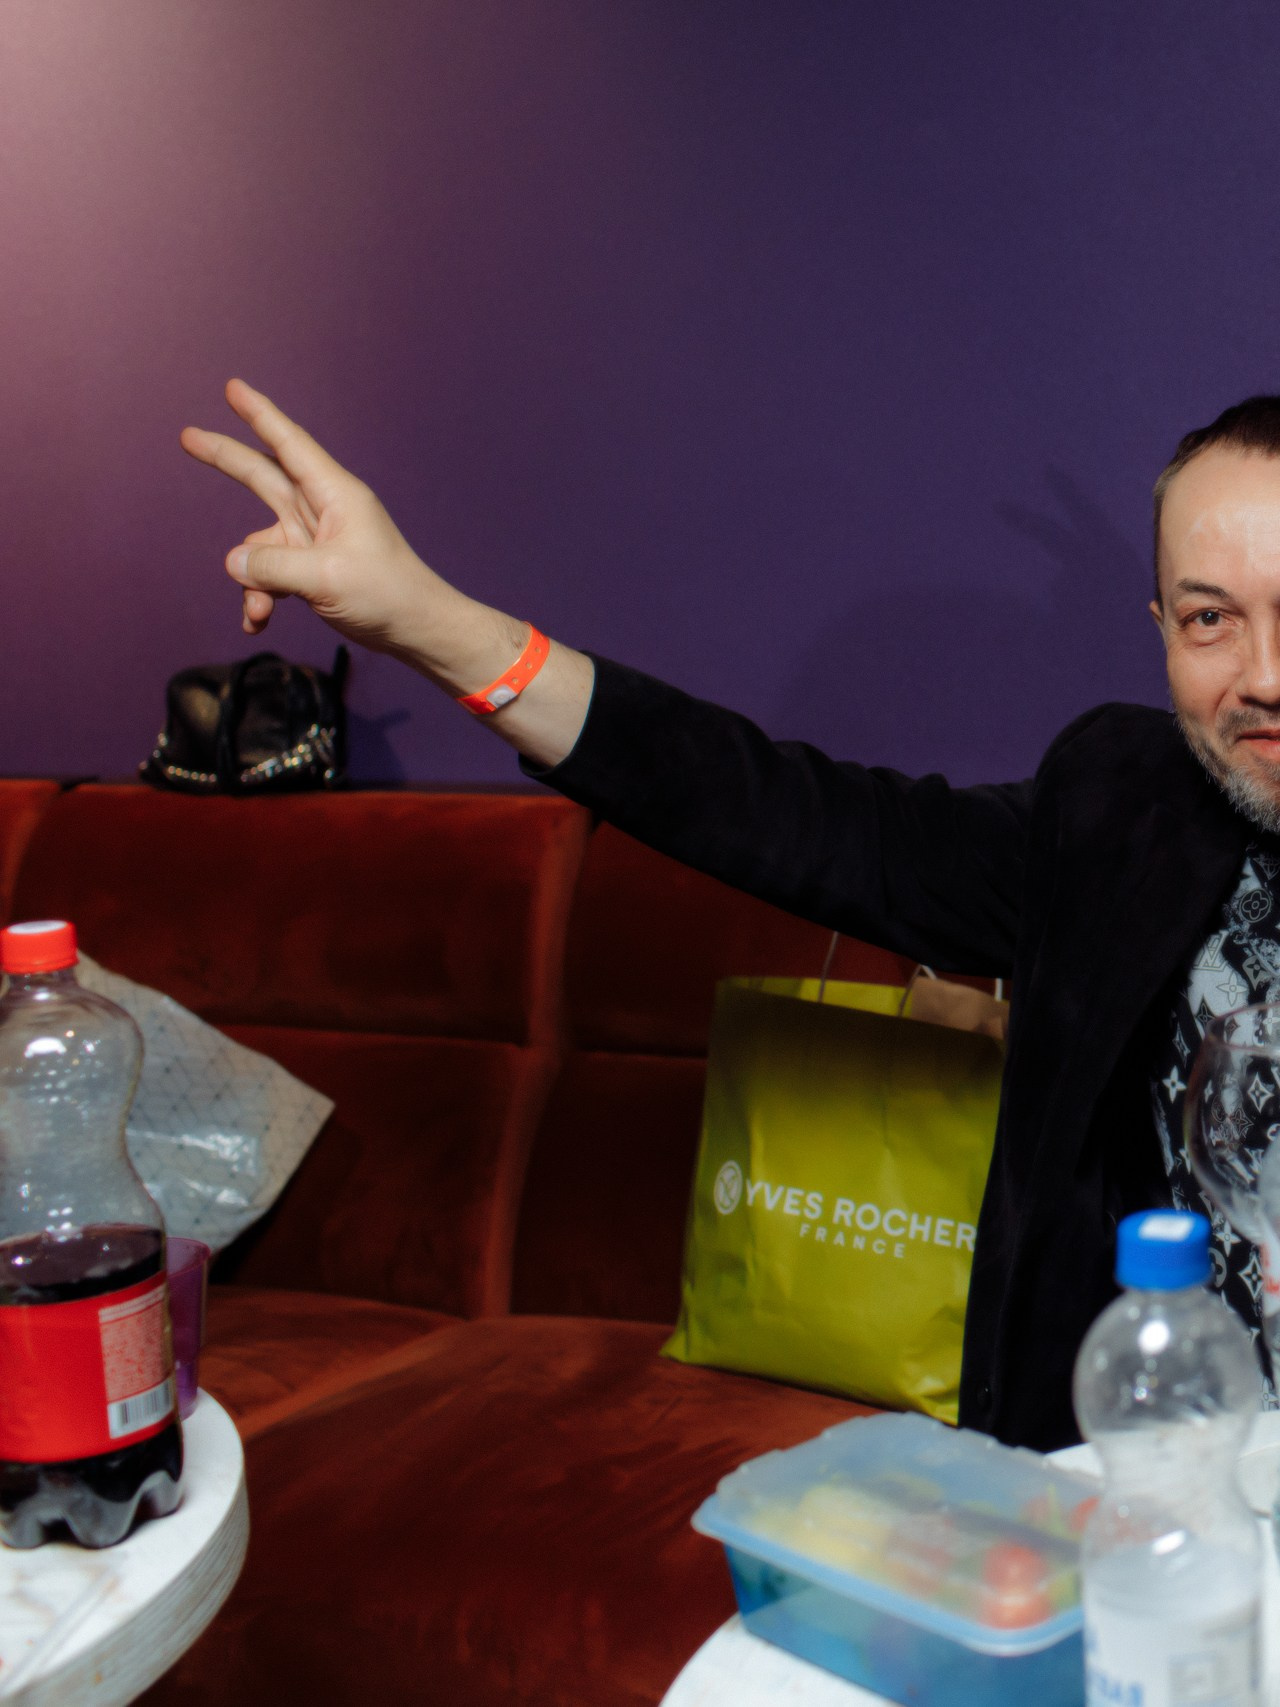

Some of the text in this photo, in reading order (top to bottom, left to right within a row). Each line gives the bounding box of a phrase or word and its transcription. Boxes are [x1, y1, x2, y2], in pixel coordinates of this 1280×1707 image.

[746, 1178, 977, 1251] YVES ROCHER
[799, 1222, 906, 1259] FRANCE
